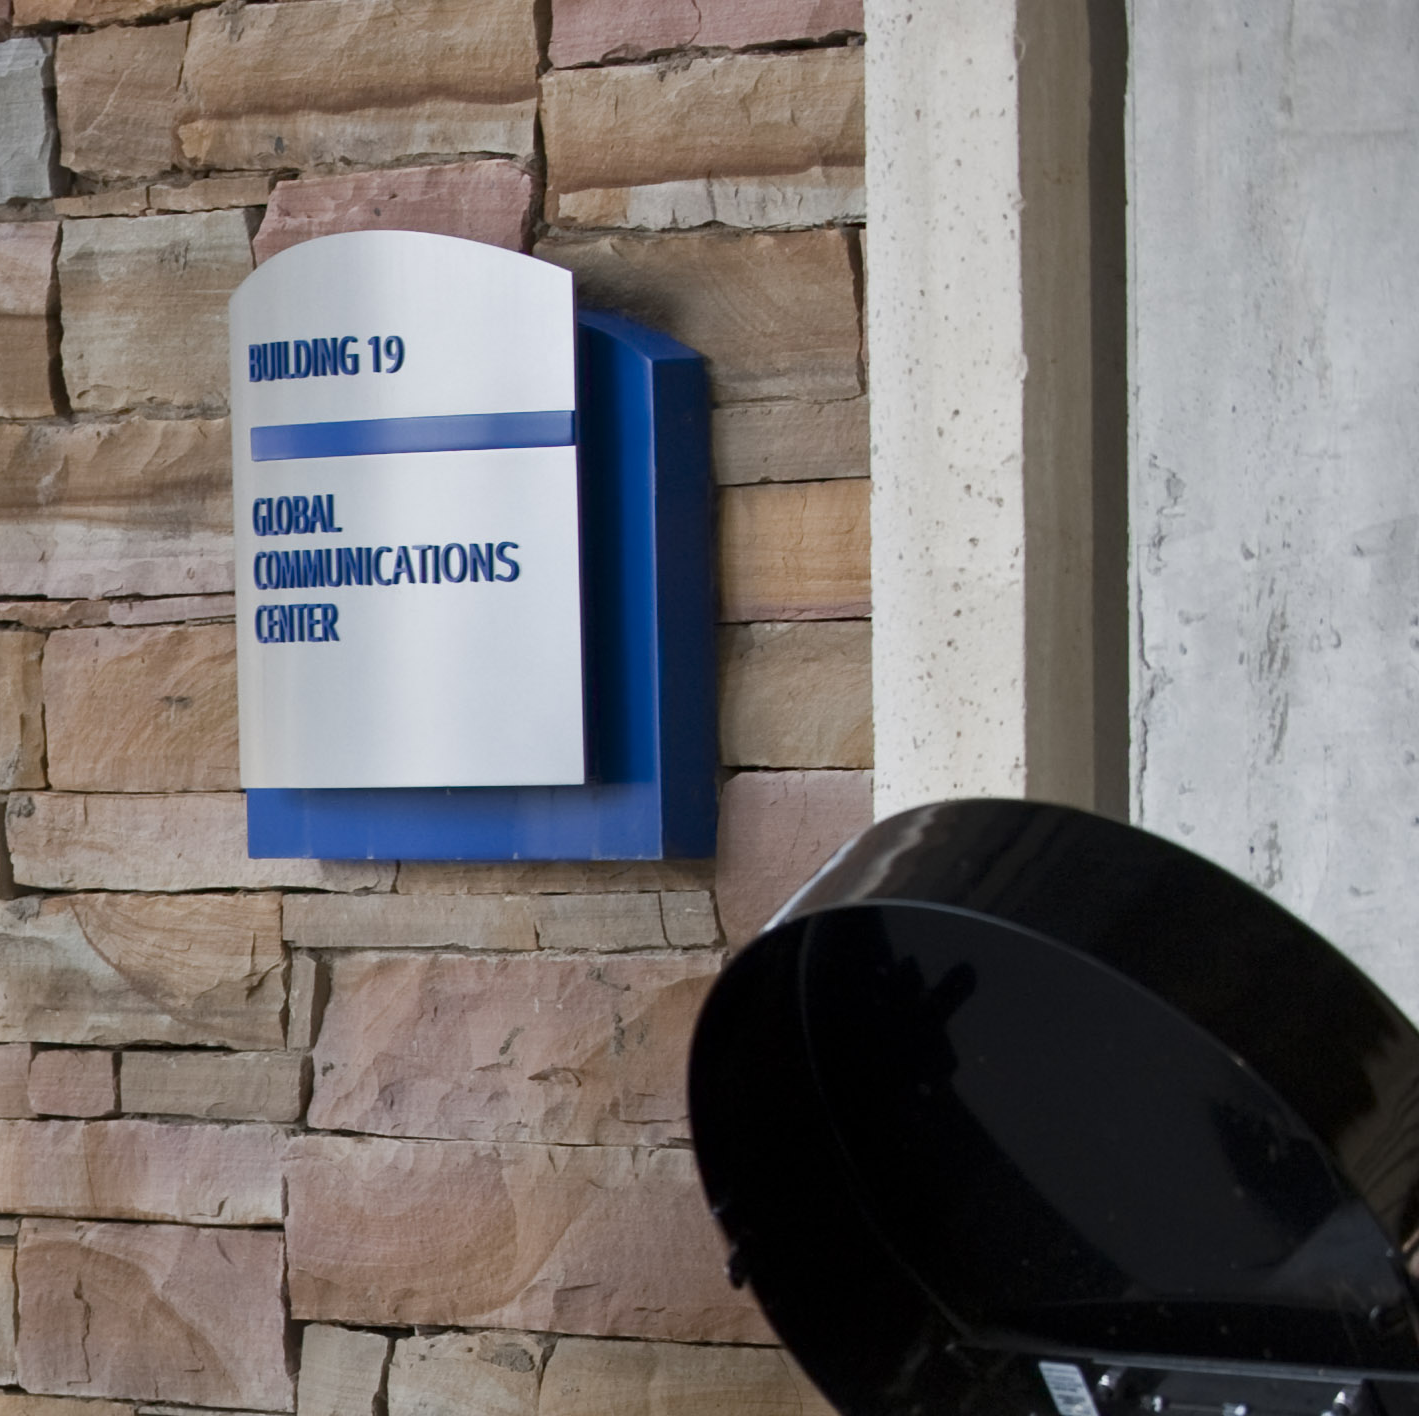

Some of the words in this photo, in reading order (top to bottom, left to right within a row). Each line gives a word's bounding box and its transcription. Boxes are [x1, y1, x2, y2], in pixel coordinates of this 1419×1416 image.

[249, 336, 360, 382] BUILDING
[367, 334, 405, 376] 19
[253, 493, 343, 536] GLOBAL
[253, 541, 521, 591] COMMUNICATIONS
[254, 602, 340, 643] CENTER
